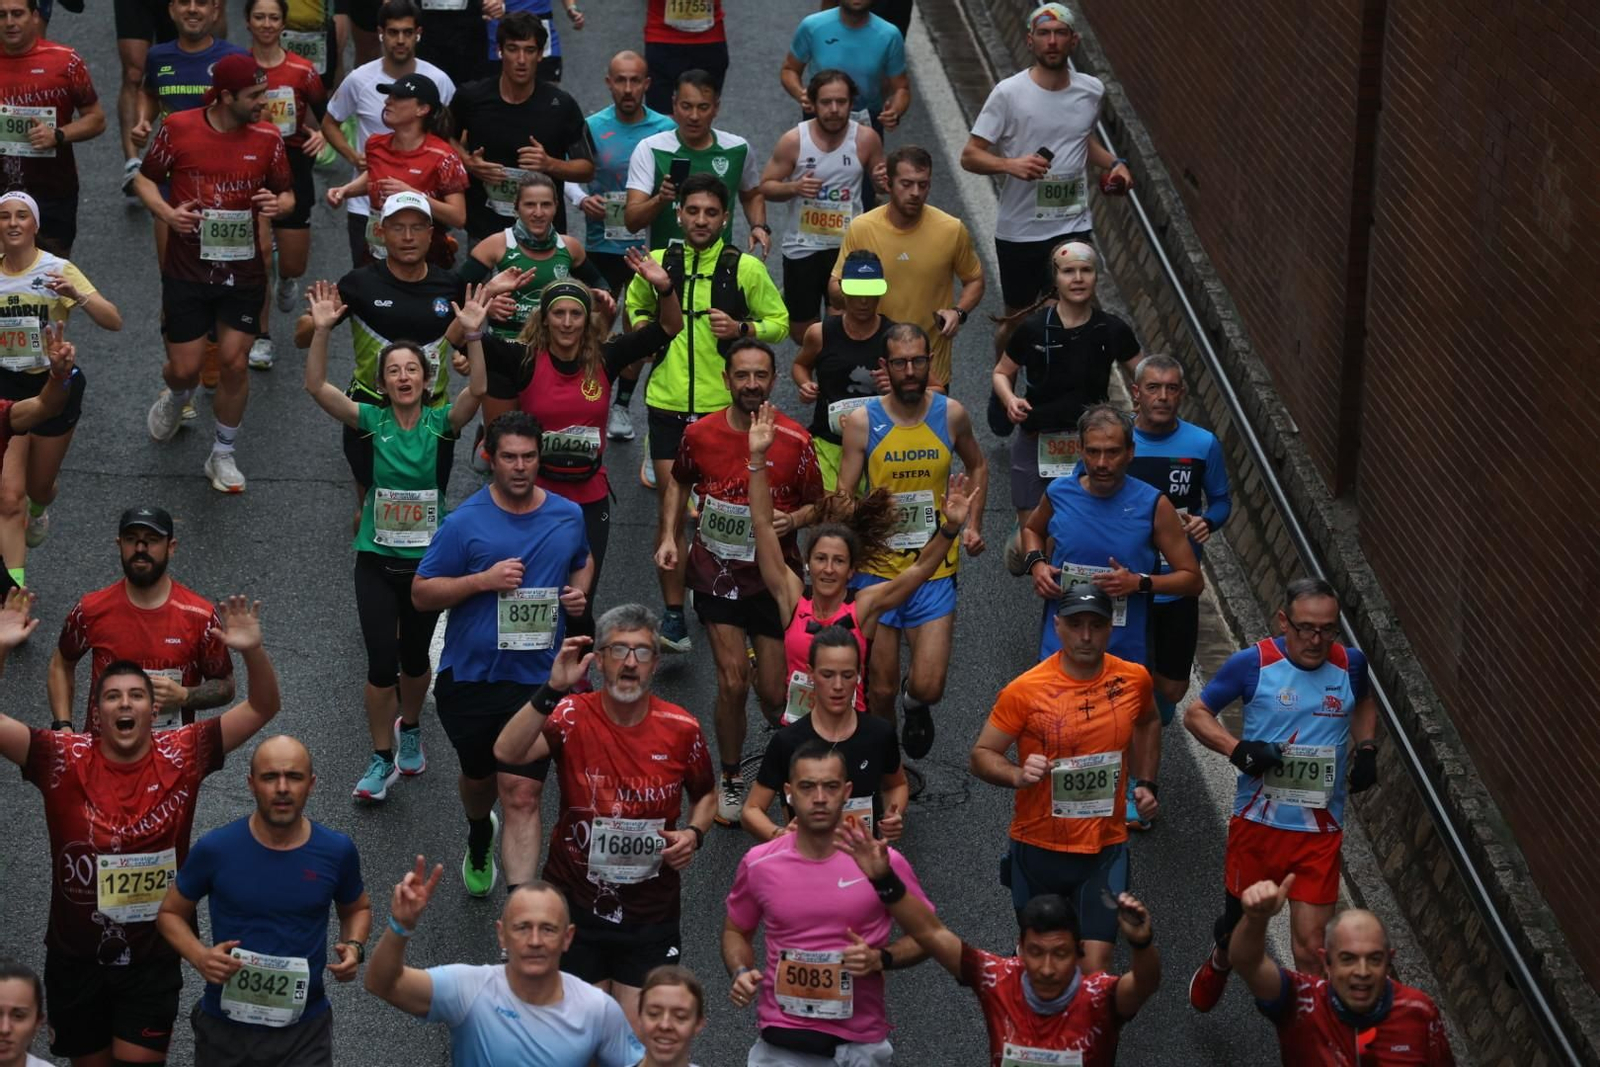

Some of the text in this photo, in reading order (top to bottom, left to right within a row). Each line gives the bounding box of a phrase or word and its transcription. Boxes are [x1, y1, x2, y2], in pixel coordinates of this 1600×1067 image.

[671, 0, 706, 13] 11755
[159, 85, 213, 95] LEBRIRUNN
[6, 118, 36, 134] 980
[817, 186, 850, 202] dea
[1045, 183, 1076, 199] 8014
[804, 210, 844, 229] 10856
[210, 223, 248, 238] 8375
[544, 436, 590, 452] 10420
[884, 449, 939, 462] ALJOPRI
[892, 469, 931, 479] ESTEPA
[1169, 470, 1191, 483] CN
[1169, 484, 1191, 496] PN
[383, 503, 423, 522] 7176
[709, 513, 745, 535] 8608
[509, 604, 548, 622] 8377
[1274, 761, 1319, 780] 8179
[1063, 770, 1107, 791] 8328
[598, 833, 655, 855] 16809
[105, 869, 167, 894] 12752
[238, 969, 289, 996] 8342
[786, 965, 833, 988] 5083
